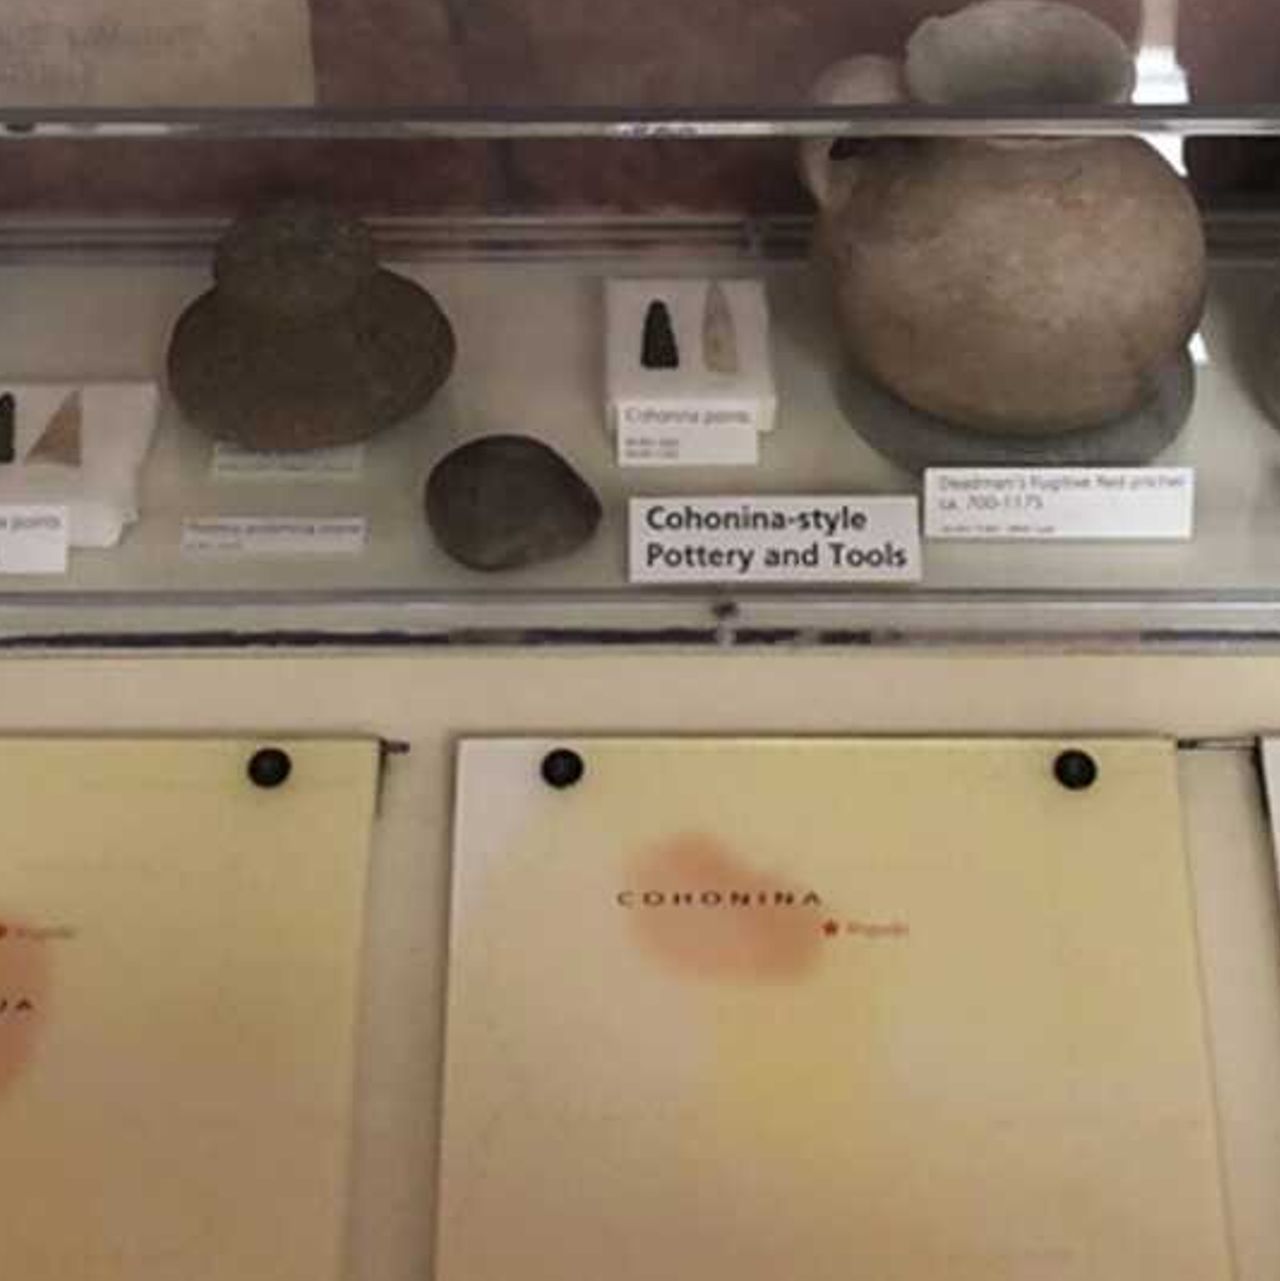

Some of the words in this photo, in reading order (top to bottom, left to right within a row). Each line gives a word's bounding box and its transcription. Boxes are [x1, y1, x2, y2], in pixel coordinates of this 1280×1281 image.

[646, 506, 866, 536] Cohonina-style
[647, 543, 754, 573] Pottery
[765, 543, 818, 566] and
[829, 543, 906, 567] Tools
[616, 891, 821, 907] COHONINA
